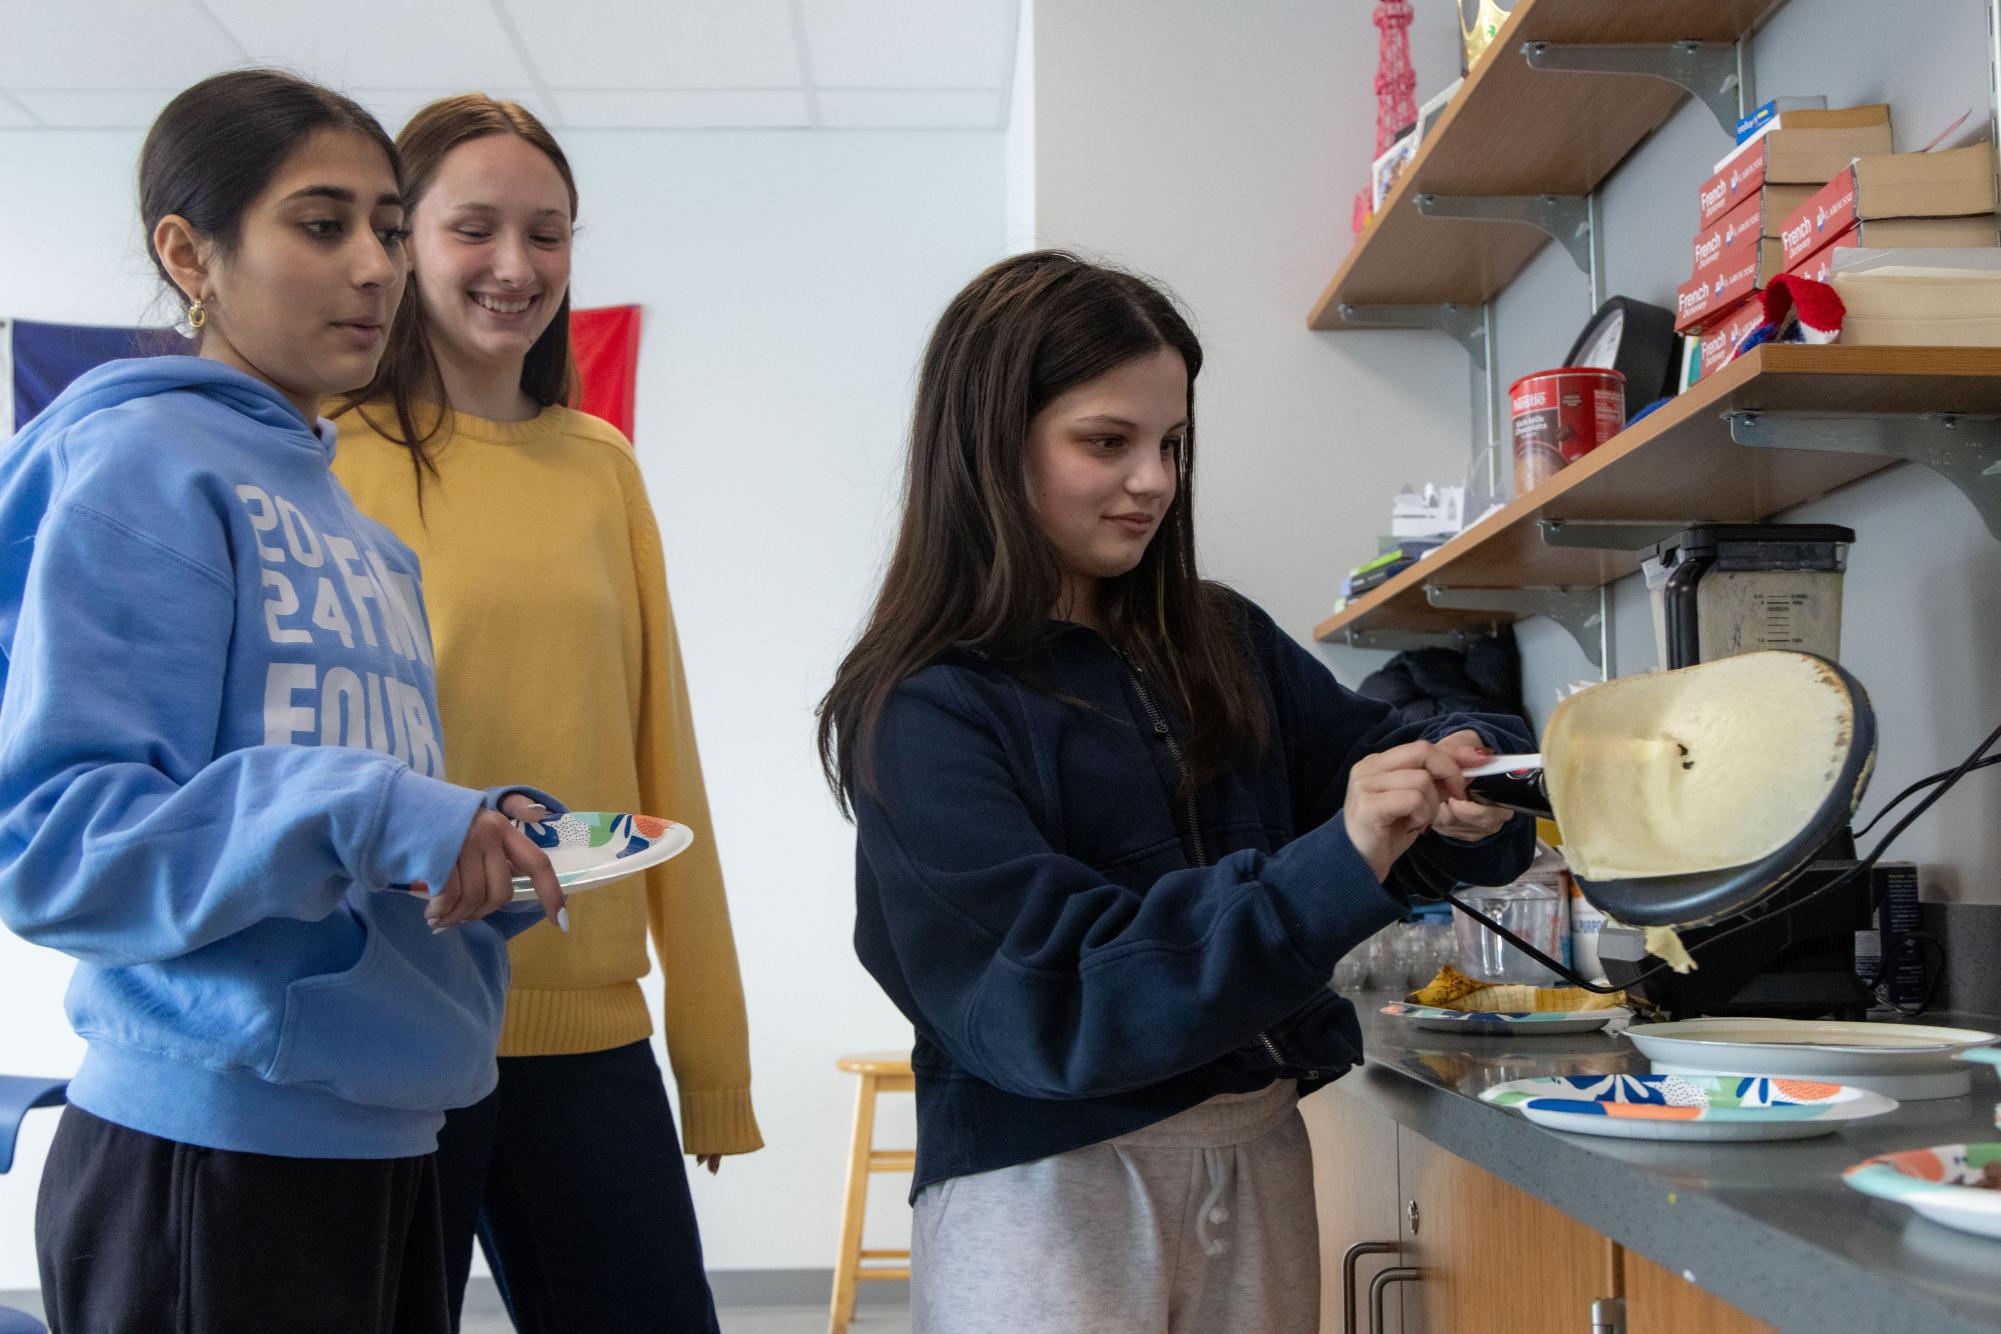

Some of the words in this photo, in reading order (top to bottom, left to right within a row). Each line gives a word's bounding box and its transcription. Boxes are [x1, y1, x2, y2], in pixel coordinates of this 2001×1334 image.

[1701, 178, 1726, 211] French
[1695, 231, 1721, 263] French
[1782, 216, 1812, 251] French
[1679, 281, 1709, 312] French
[1701, 330, 1727, 361] French
[235, 484, 323, 567] 20
[262, 568, 355, 648] 24
[263, 662, 445, 778] FOUR
